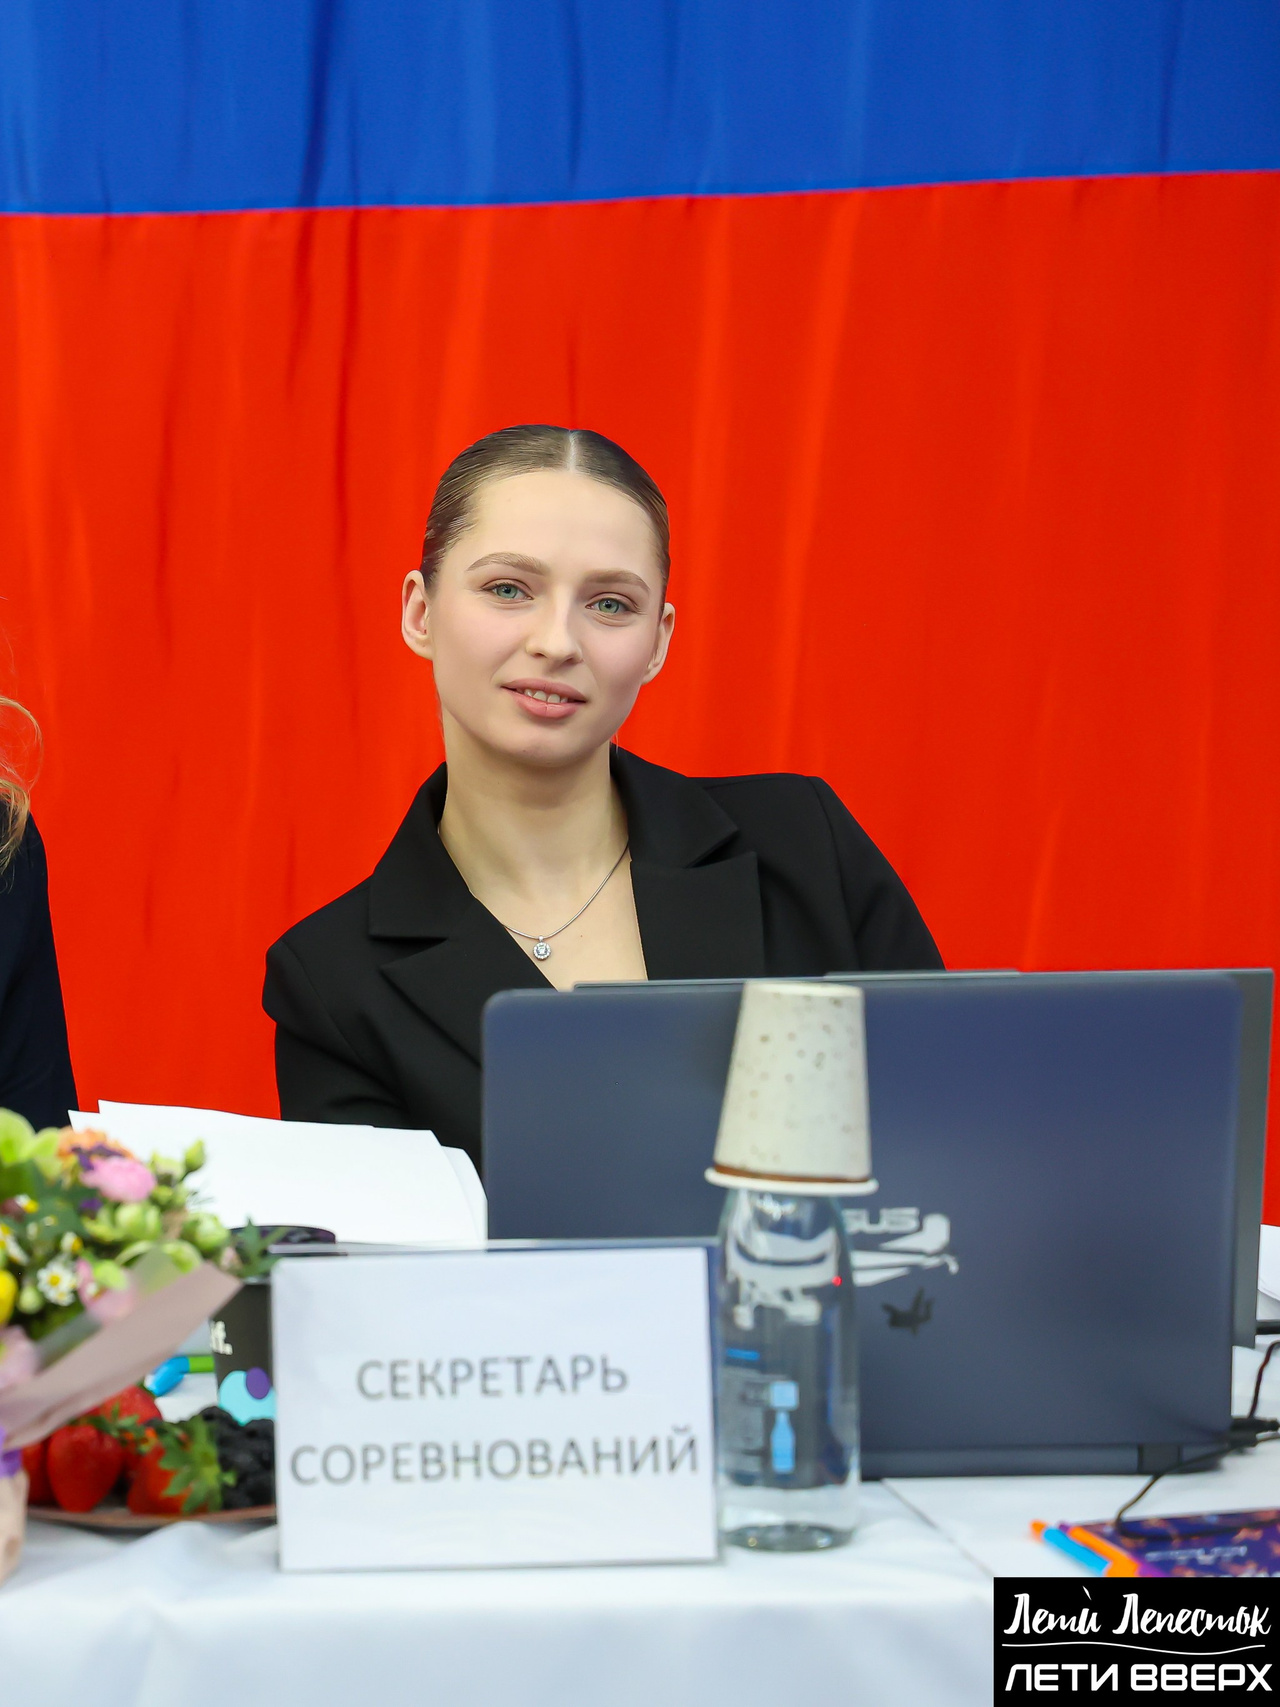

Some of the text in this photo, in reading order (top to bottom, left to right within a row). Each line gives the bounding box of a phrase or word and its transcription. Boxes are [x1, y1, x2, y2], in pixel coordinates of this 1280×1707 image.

[841, 1206, 921, 1236] SUS
[356, 1354, 630, 1401] СЕКРЕТАРЬ
[289, 1424, 702, 1486] СОРЕВНОВАНИЙ
